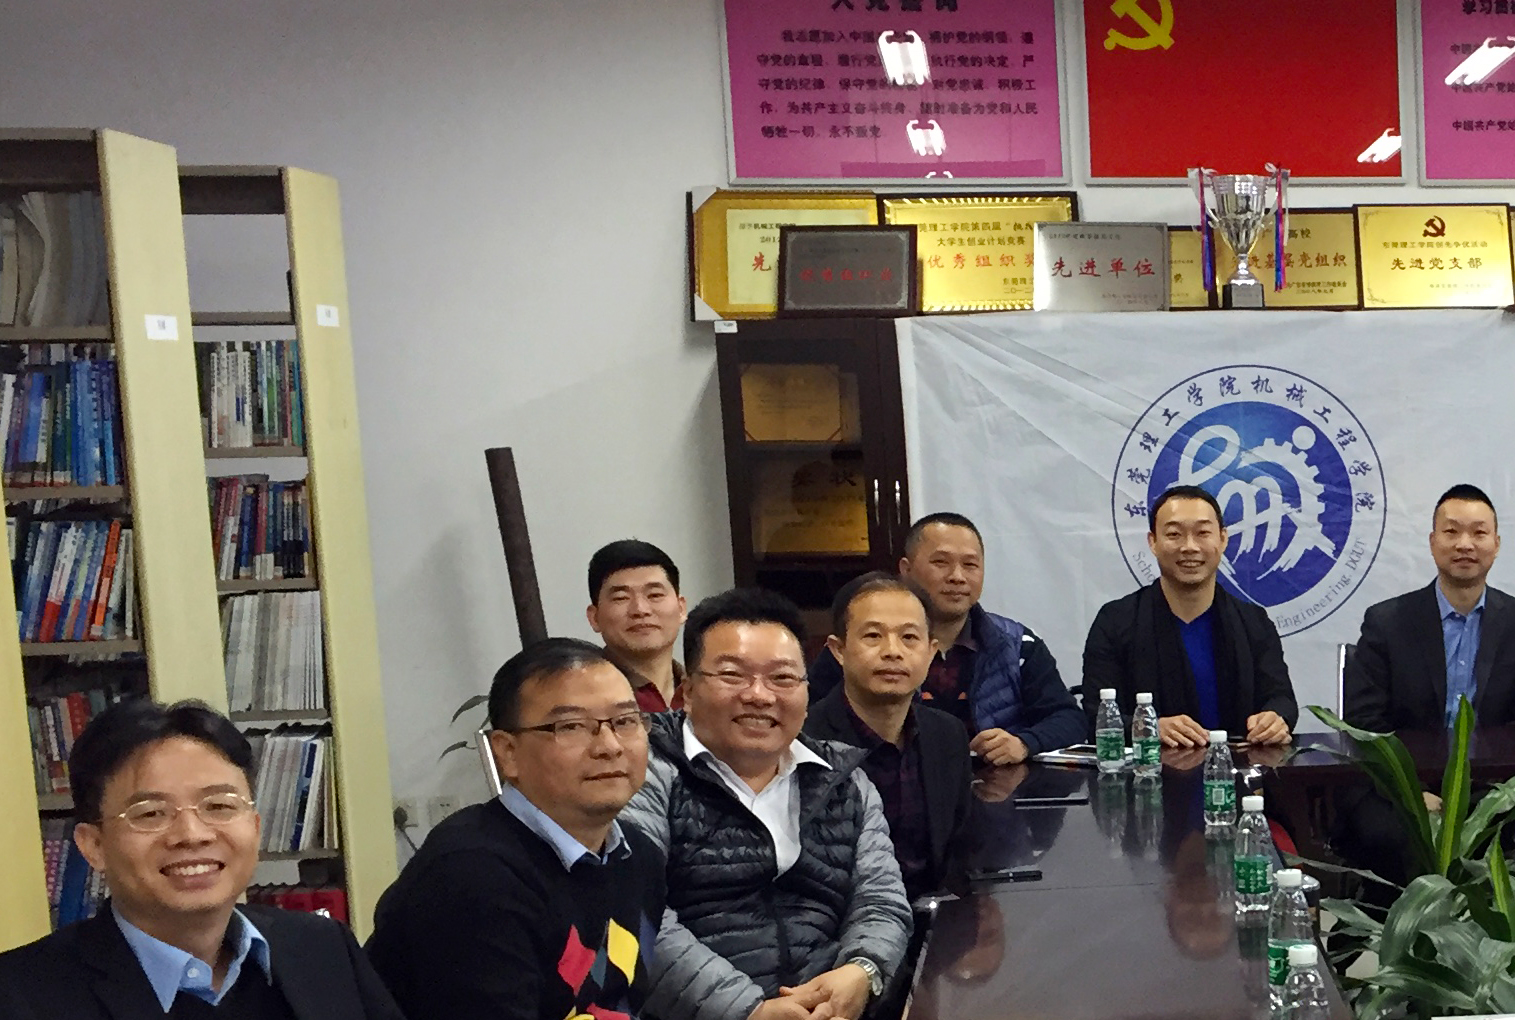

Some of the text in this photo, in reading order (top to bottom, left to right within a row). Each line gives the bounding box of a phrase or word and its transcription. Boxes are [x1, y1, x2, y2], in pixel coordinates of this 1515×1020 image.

[1051, 256, 1155, 279] 先进单位
[1391, 256, 1483, 271] 先进党支部
